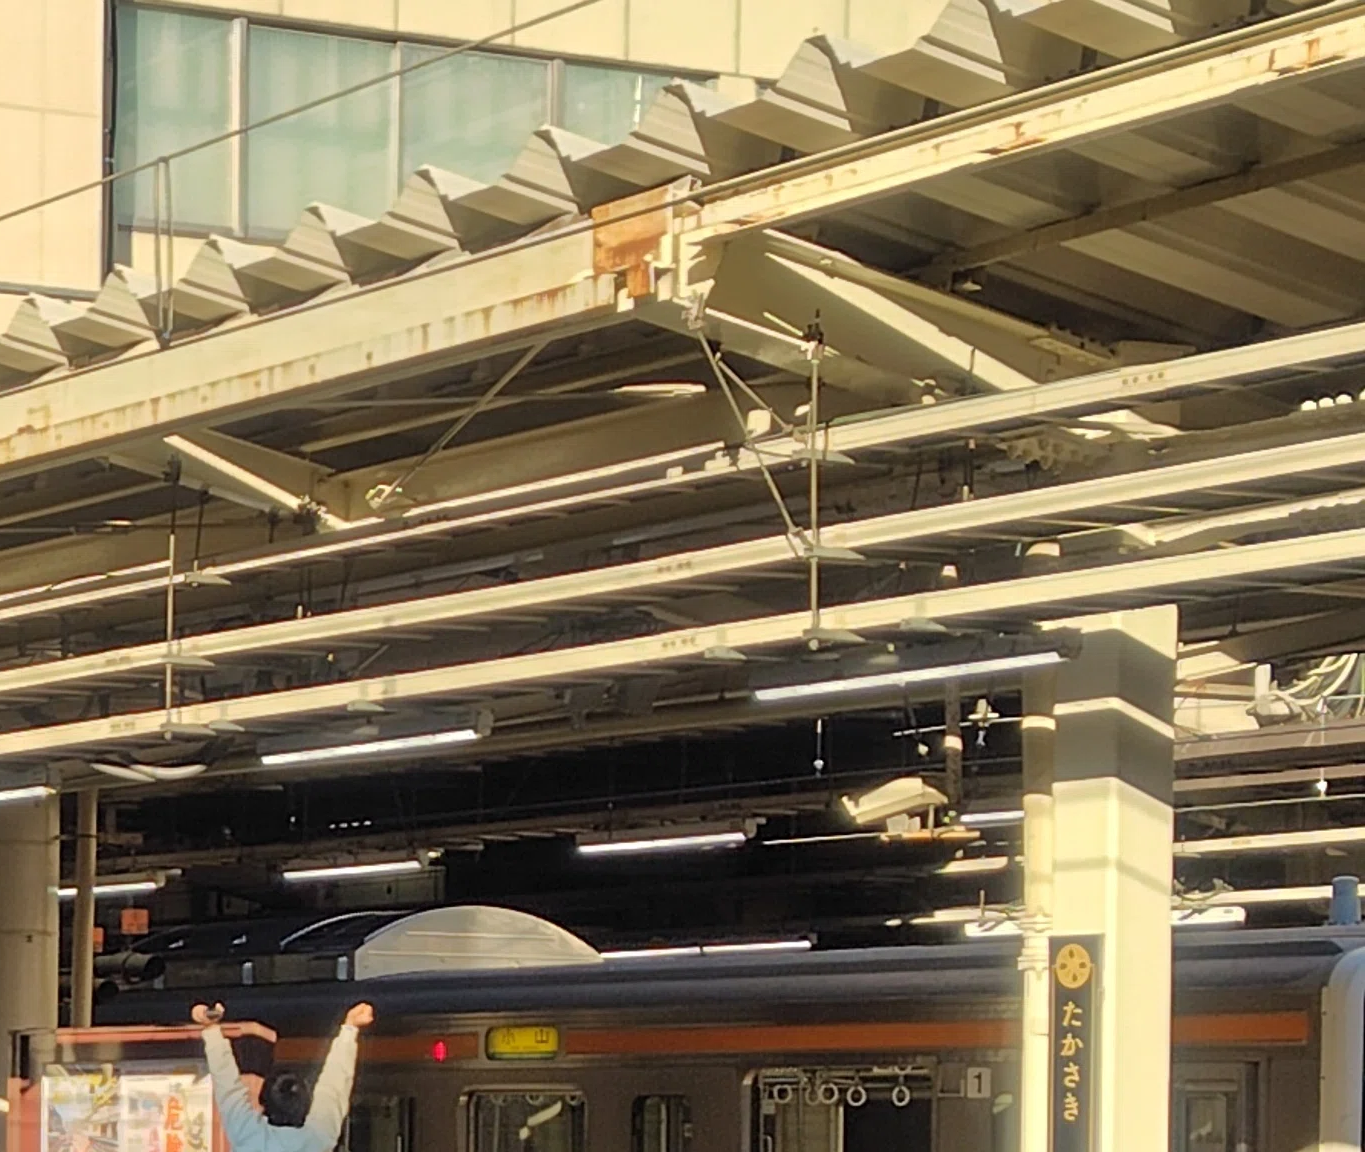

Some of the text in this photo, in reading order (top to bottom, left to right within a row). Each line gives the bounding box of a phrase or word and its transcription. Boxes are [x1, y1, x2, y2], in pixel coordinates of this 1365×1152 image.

[972, 1072, 983, 1094] 1
[1060, 1001, 1084, 1121] たかさき
